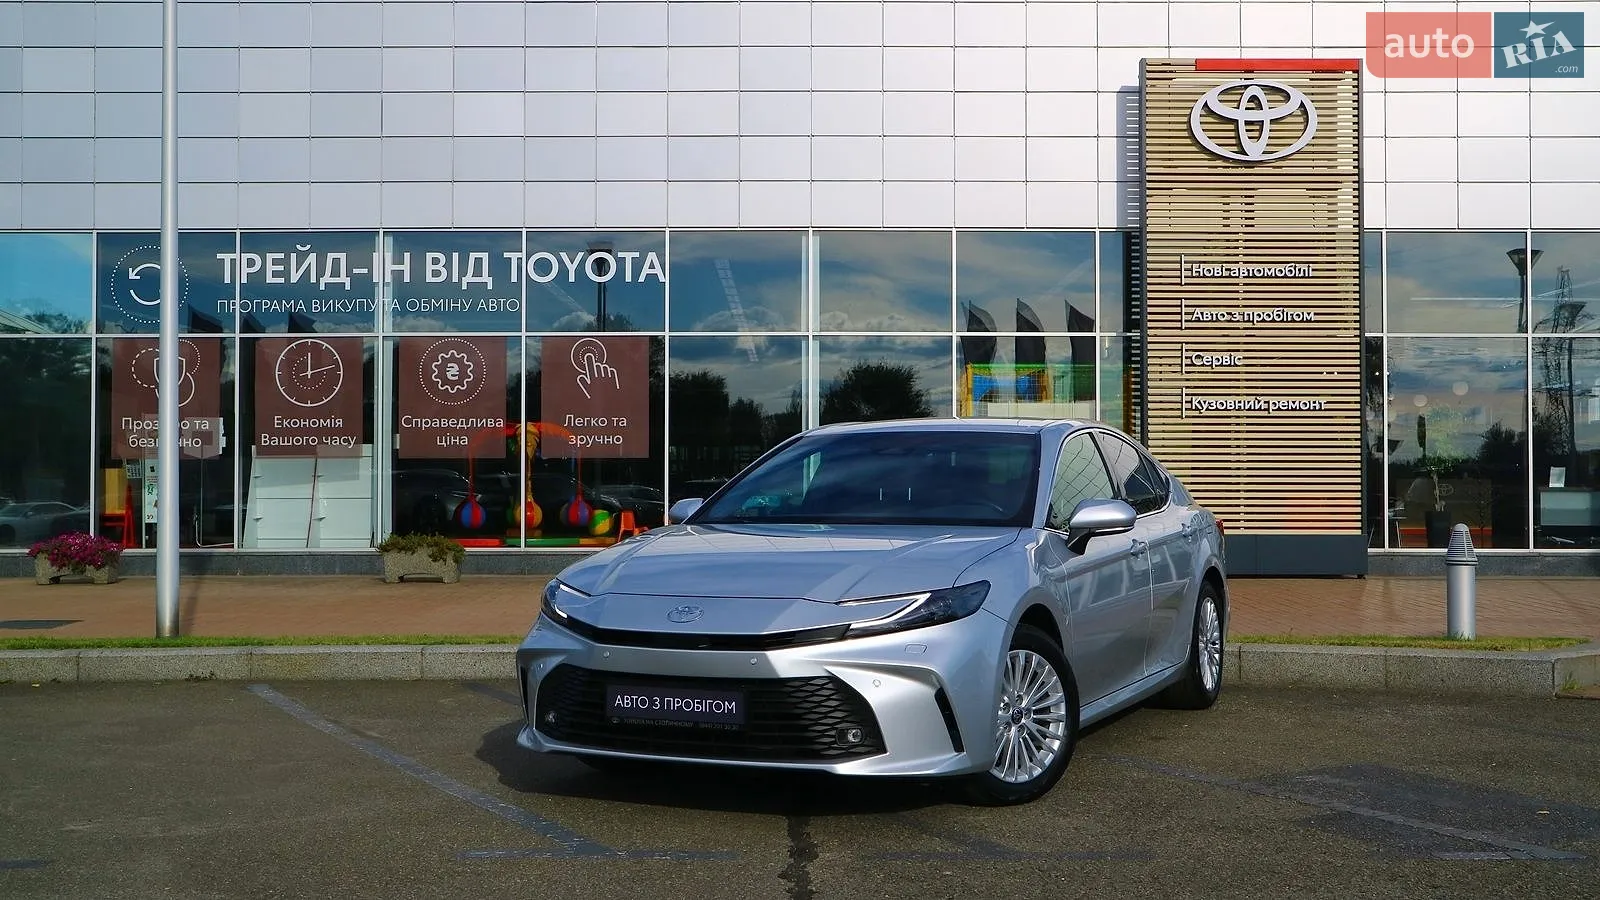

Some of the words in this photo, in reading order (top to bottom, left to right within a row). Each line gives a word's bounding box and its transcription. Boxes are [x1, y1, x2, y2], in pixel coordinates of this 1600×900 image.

[216, 244, 411, 291] ТРЕЙД-ІН
[425, 251, 493, 290] ВІД
[503, 251, 666, 283] TOYOTA
[1192, 263, 1229, 278] Нові
[1230, 263, 1313, 278] автомобілі
[217, 299, 307, 313] ПРОГРАМА
[311, 298, 378, 312] ВИКУПУ
[381, 298, 401, 312] ТА
[406, 298, 474, 312] ОБМІНУ
[476, 298, 520, 312] АВТО
[1192, 308, 1228, 321] Авто
[1231, 311, 1239, 321] з
[1243, 307, 1315, 324] пробігом
[1191, 352, 1244, 369] Сервіс
[1192, 396, 1265, 413] Кузовний
[1269, 399, 1327, 413] ремонт
[122, 417, 190, 432] Прозо
[194, 420, 209, 430] та
[274, 415, 343, 428] Економія
[401, 415, 504, 429] Справедлива
[563, 414, 607, 427] Легко
[611, 417, 627, 427] та
[128, 434, 202, 448] безно
[261, 433, 318, 446] Вашого
[322, 436, 357, 449] часу
[436, 432, 469, 446] ціна
[568, 435, 623, 446] зручно
[614, 695, 649, 709] АВТО
[664, 698, 736, 714] ПРОБІГОМ
